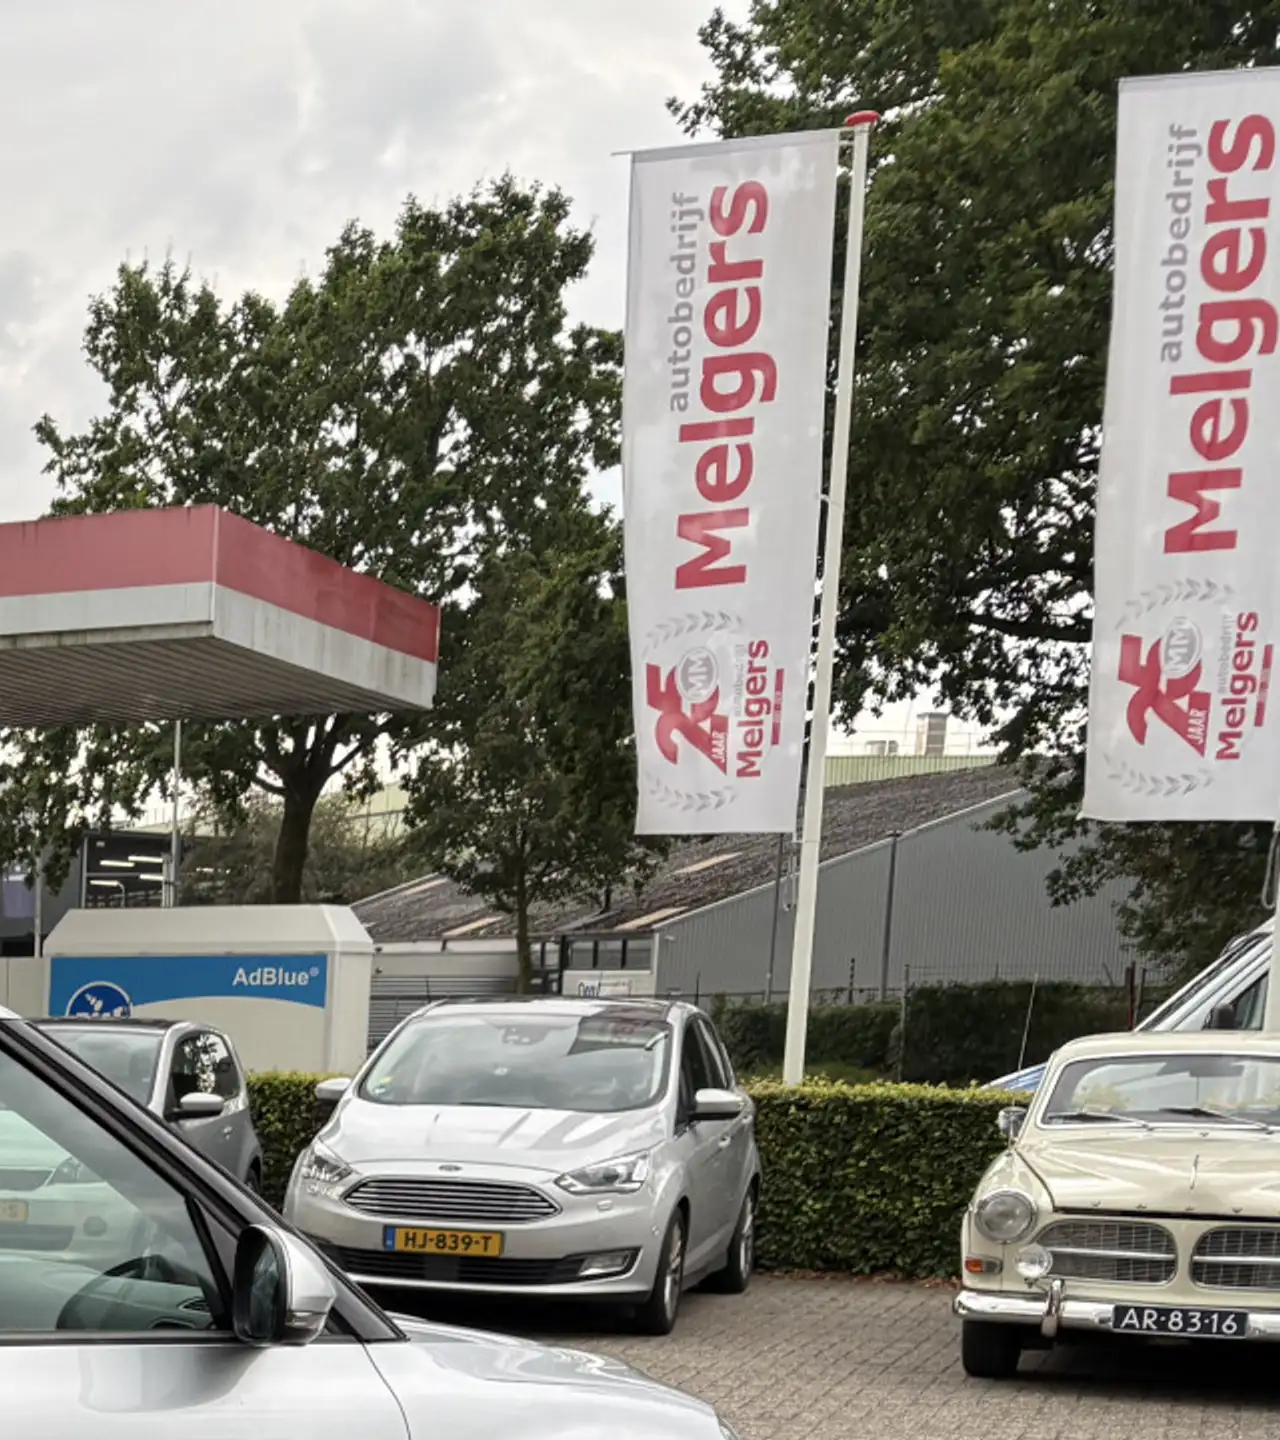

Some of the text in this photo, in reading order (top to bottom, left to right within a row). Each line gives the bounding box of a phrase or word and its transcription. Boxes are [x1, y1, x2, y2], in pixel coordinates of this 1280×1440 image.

[667, 191, 705, 414] autobedrijf
[1160, 122, 1203, 364] autobedrijf
[674, 179, 779, 591] Melgers
[1163, 113, 1279, 555] Melgers
[711, 731, 727, 764] JAAR
[736, 639, 772, 778] Melgers
[1188, 707, 1208, 745] JAAR
[1215, 611, 1259, 761] Melgers
[403, 1230, 493, 1253] HJ-839-T
